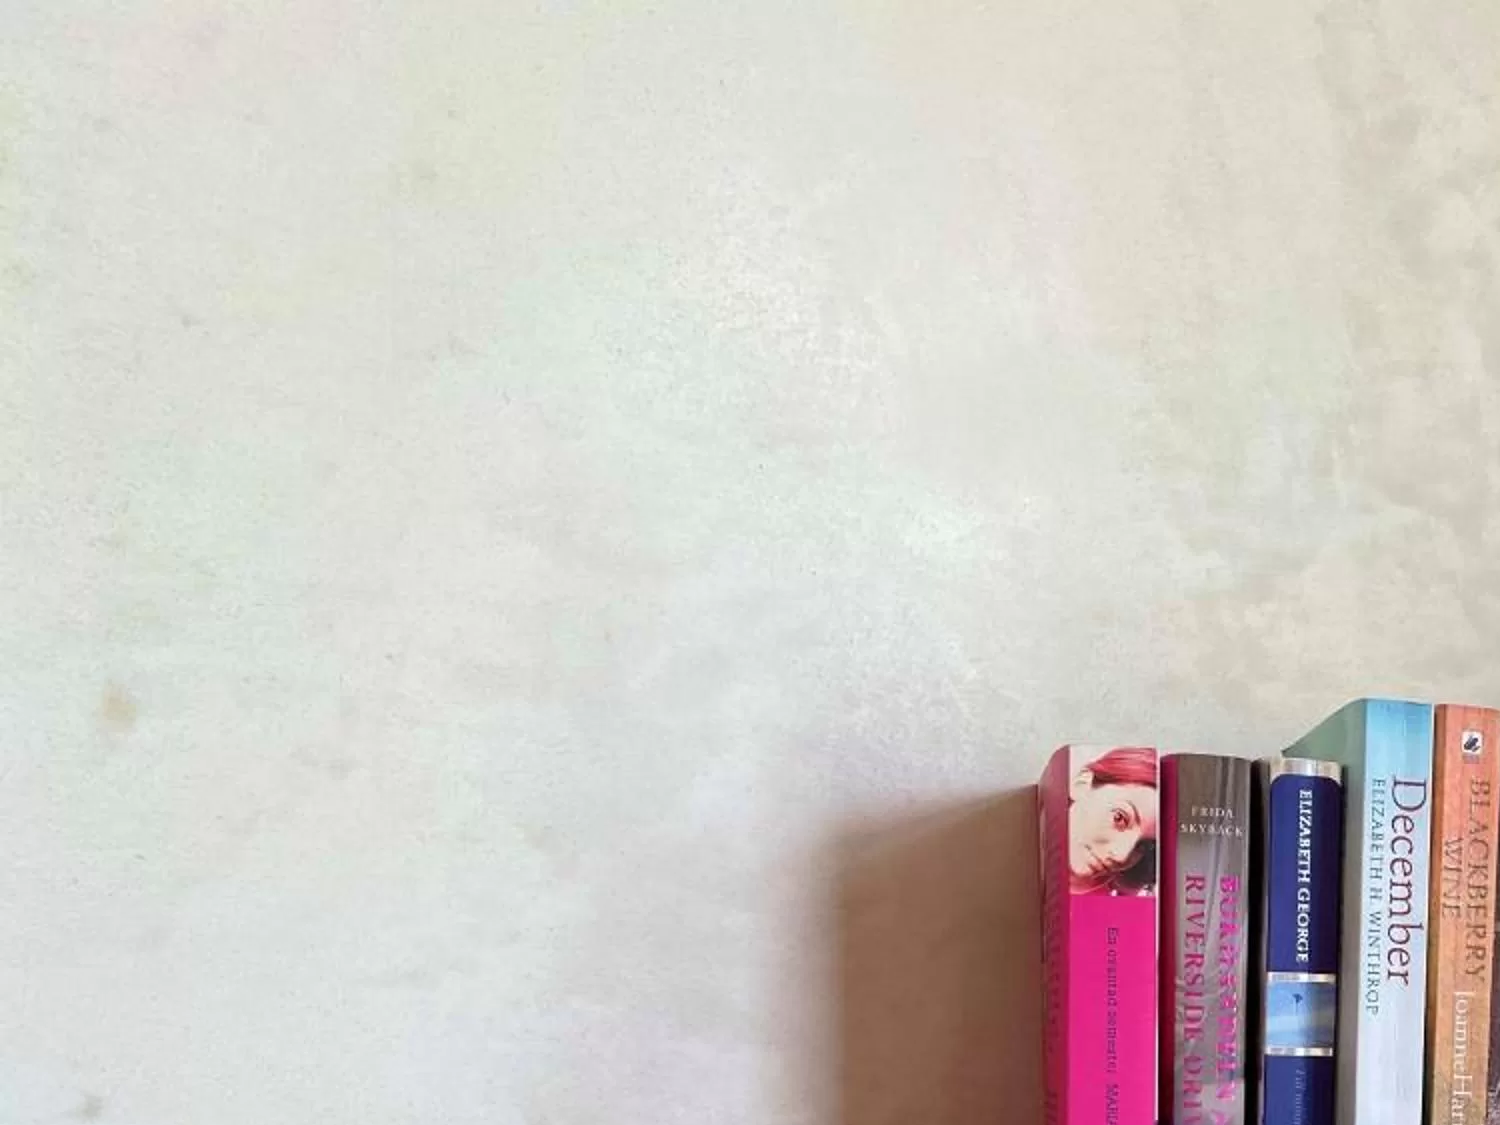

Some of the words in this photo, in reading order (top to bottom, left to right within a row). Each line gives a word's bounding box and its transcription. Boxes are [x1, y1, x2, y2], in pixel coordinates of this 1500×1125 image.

[1296, 790, 1313, 883] ELIZABETH
[1368, 778, 1386, 881] ELIZABETH
[1440, 837, 1464, 922] WINE
[1464, 779, 1491, 983] BLACKBERRY
[1294, 887, 1311, 964] GEORGE
[1387, 775, 1428, 988] December
[1182, 874, 1207, 1042] RIVERSIDE
[1364, 910, 1380, 1017] WINTHROP
[1451, 990, 1477, 1073] Joanne
